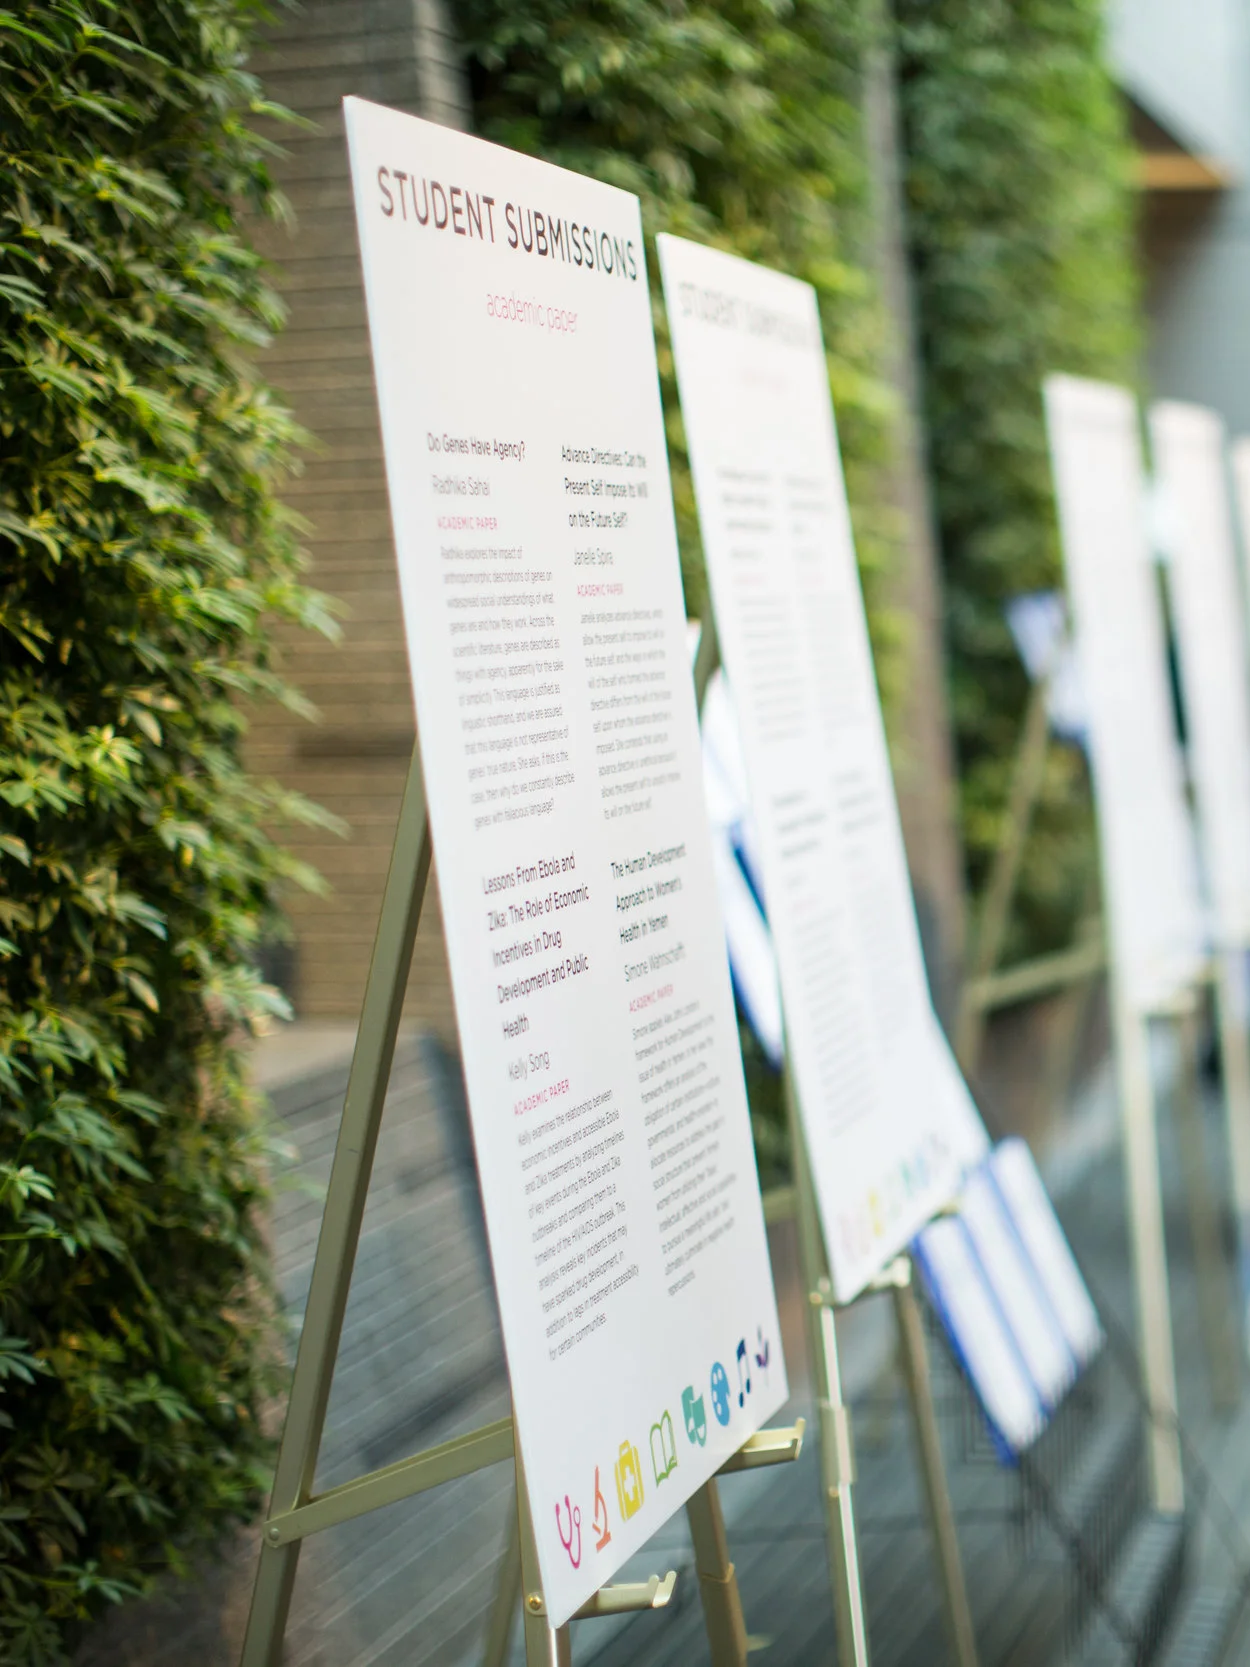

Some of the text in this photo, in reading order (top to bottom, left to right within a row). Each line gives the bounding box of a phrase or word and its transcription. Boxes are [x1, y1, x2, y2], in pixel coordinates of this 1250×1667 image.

[377, 166, 637, 281] STUDENT SUBMISSIONS
[487, 293, 578, 333] academic paper
[427, 432, 525, 462] Do Genes Have Agency?
[562, 445, 647, 468] Advance Directives: Can the
[432, 475, 467, 495] Radhika
[564, 477, 590, 495] Present
[590, 479, 603, 496] Self
[604, 483, 627, 498] Impose
[627, 482, 636, 498] Its
[437, 516, 498, 530] ACADEMIC PAPER
[569, 511, 628, 528] on the Future Self?
[574, 549, 596, 565] Janelle
[577, 583, 623, 597] ACADEMIC PAPER
[484, 856, 575, 895] Lessons From Ebola and
[610, 843, 686, 878] The Human Development
[487, 883, 589, 932] Zika: The Role of Economic
[616, 878, 682, 912] Approach to Women's
[620, 914, 668, 943] Health in Yemen
[493, 931, 562, 966] Incentives in Drug
[497, 954, 589, 1004] Development and Public
[624, 961, 648, 982] Simone
[629, 984, 674, 1012] ACADEMIC PAPER
[503, 1014, 529, 1038] Health
[508, 1051, 550, 1081] Kelly Song
[514, 1079, 569, 1115] ACADEMIC PAPER
[517, 1089, 612, 1146] Kelly examines the relationship between
[521, 1110, 619, 1171] economic incentives and accessible Ebola
[524, 1129, 625, 1195] and Zika treatments by analyzing timelines
[528, 1156, 621, 1219] of key events during the Ebola and Zika
[532, 1183, 616, 1243] outbreaks and comparing them to a
[534, 1245, 556, 1267] timeline
[556, 1238, 562, 1253] of
[562, 1236, 572, 1249] the
[615, 1200, 626, 1214] This
[538, 1225, 627, 1291] analysis reveals key incidents that may
[542, 1297, 556, 1313] have
[555, 1280, 576, 1306] sparked
[575, 1275, 588, 1291] drug
[618, 1249, 624, 1262] in
[545, 1264, 639, 1338] addition to lags in treatment accessibility
[549, 1348, 557, 1361] for
[557, 1335, 576, 1356] certain
